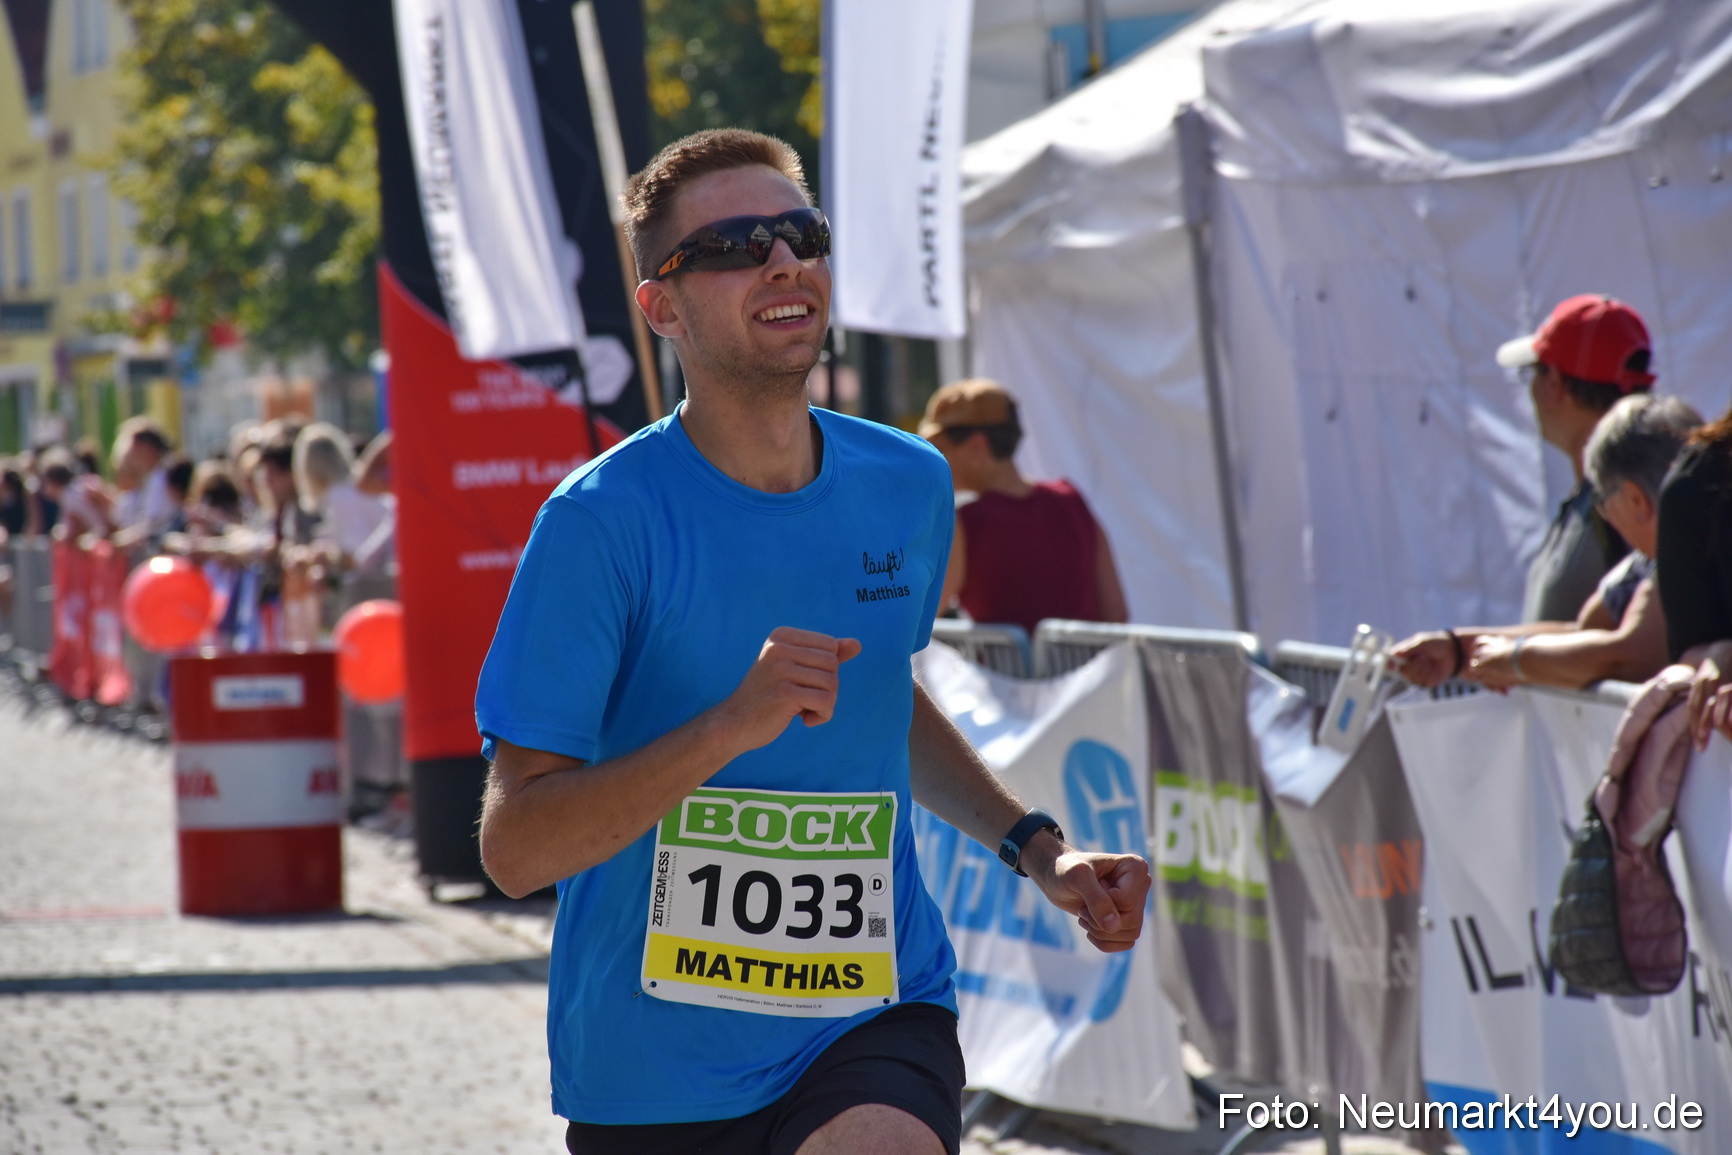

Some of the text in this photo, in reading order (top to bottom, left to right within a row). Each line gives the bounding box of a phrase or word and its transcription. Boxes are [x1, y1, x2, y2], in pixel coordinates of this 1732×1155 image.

[916, 173, 941, 309] PARTL
[862, 547, 904, 581] läuft!
[856, 584, 911, 603] Matthias
[682, 798, 877, 850] BOCK
[688, 863, 864, 940] 1033
[872, 878, 882, 891] D
[675, 947, 864, 991] MATTHIAS
